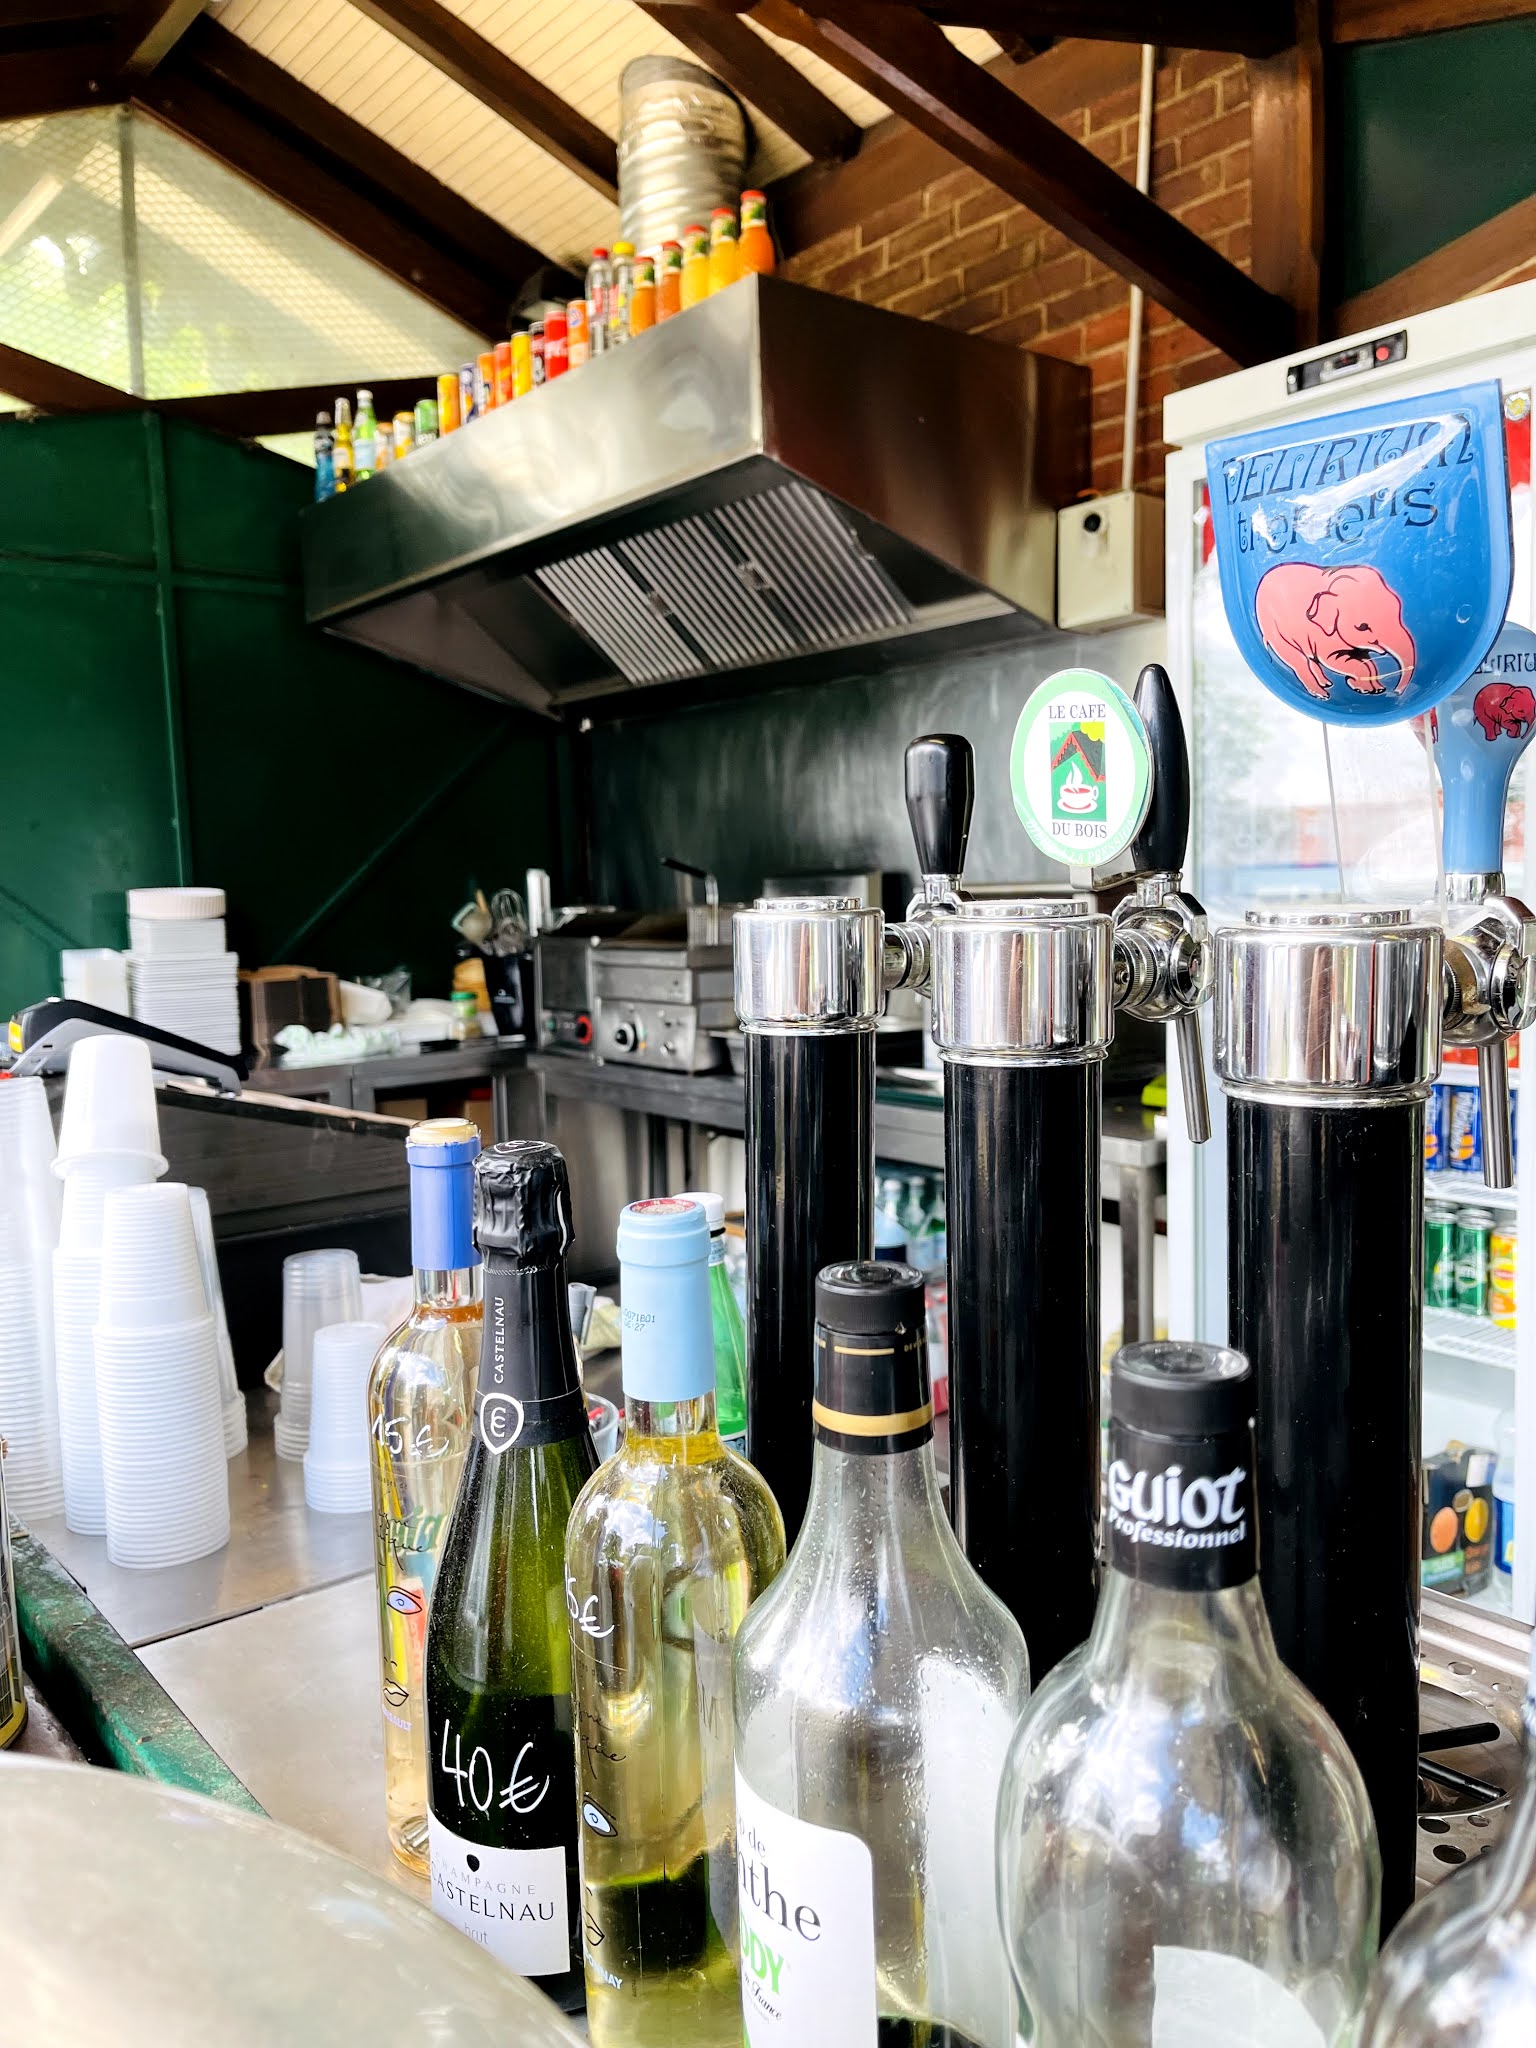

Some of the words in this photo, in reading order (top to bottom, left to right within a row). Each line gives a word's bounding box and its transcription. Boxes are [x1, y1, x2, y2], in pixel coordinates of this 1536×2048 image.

[1049, 705, 1066, 720] LE
[1069, 704, 1106, 719] CAFE
[1052, 822, 1071, 836] DU
[1075, 823, 1108, 839] BOIS
[494, 1296, 505, 1384] CASTELNAU
[1108, 1459, 1247, 1529] Guiot
[1108, 1506, 1247, 1550] Professionnel
